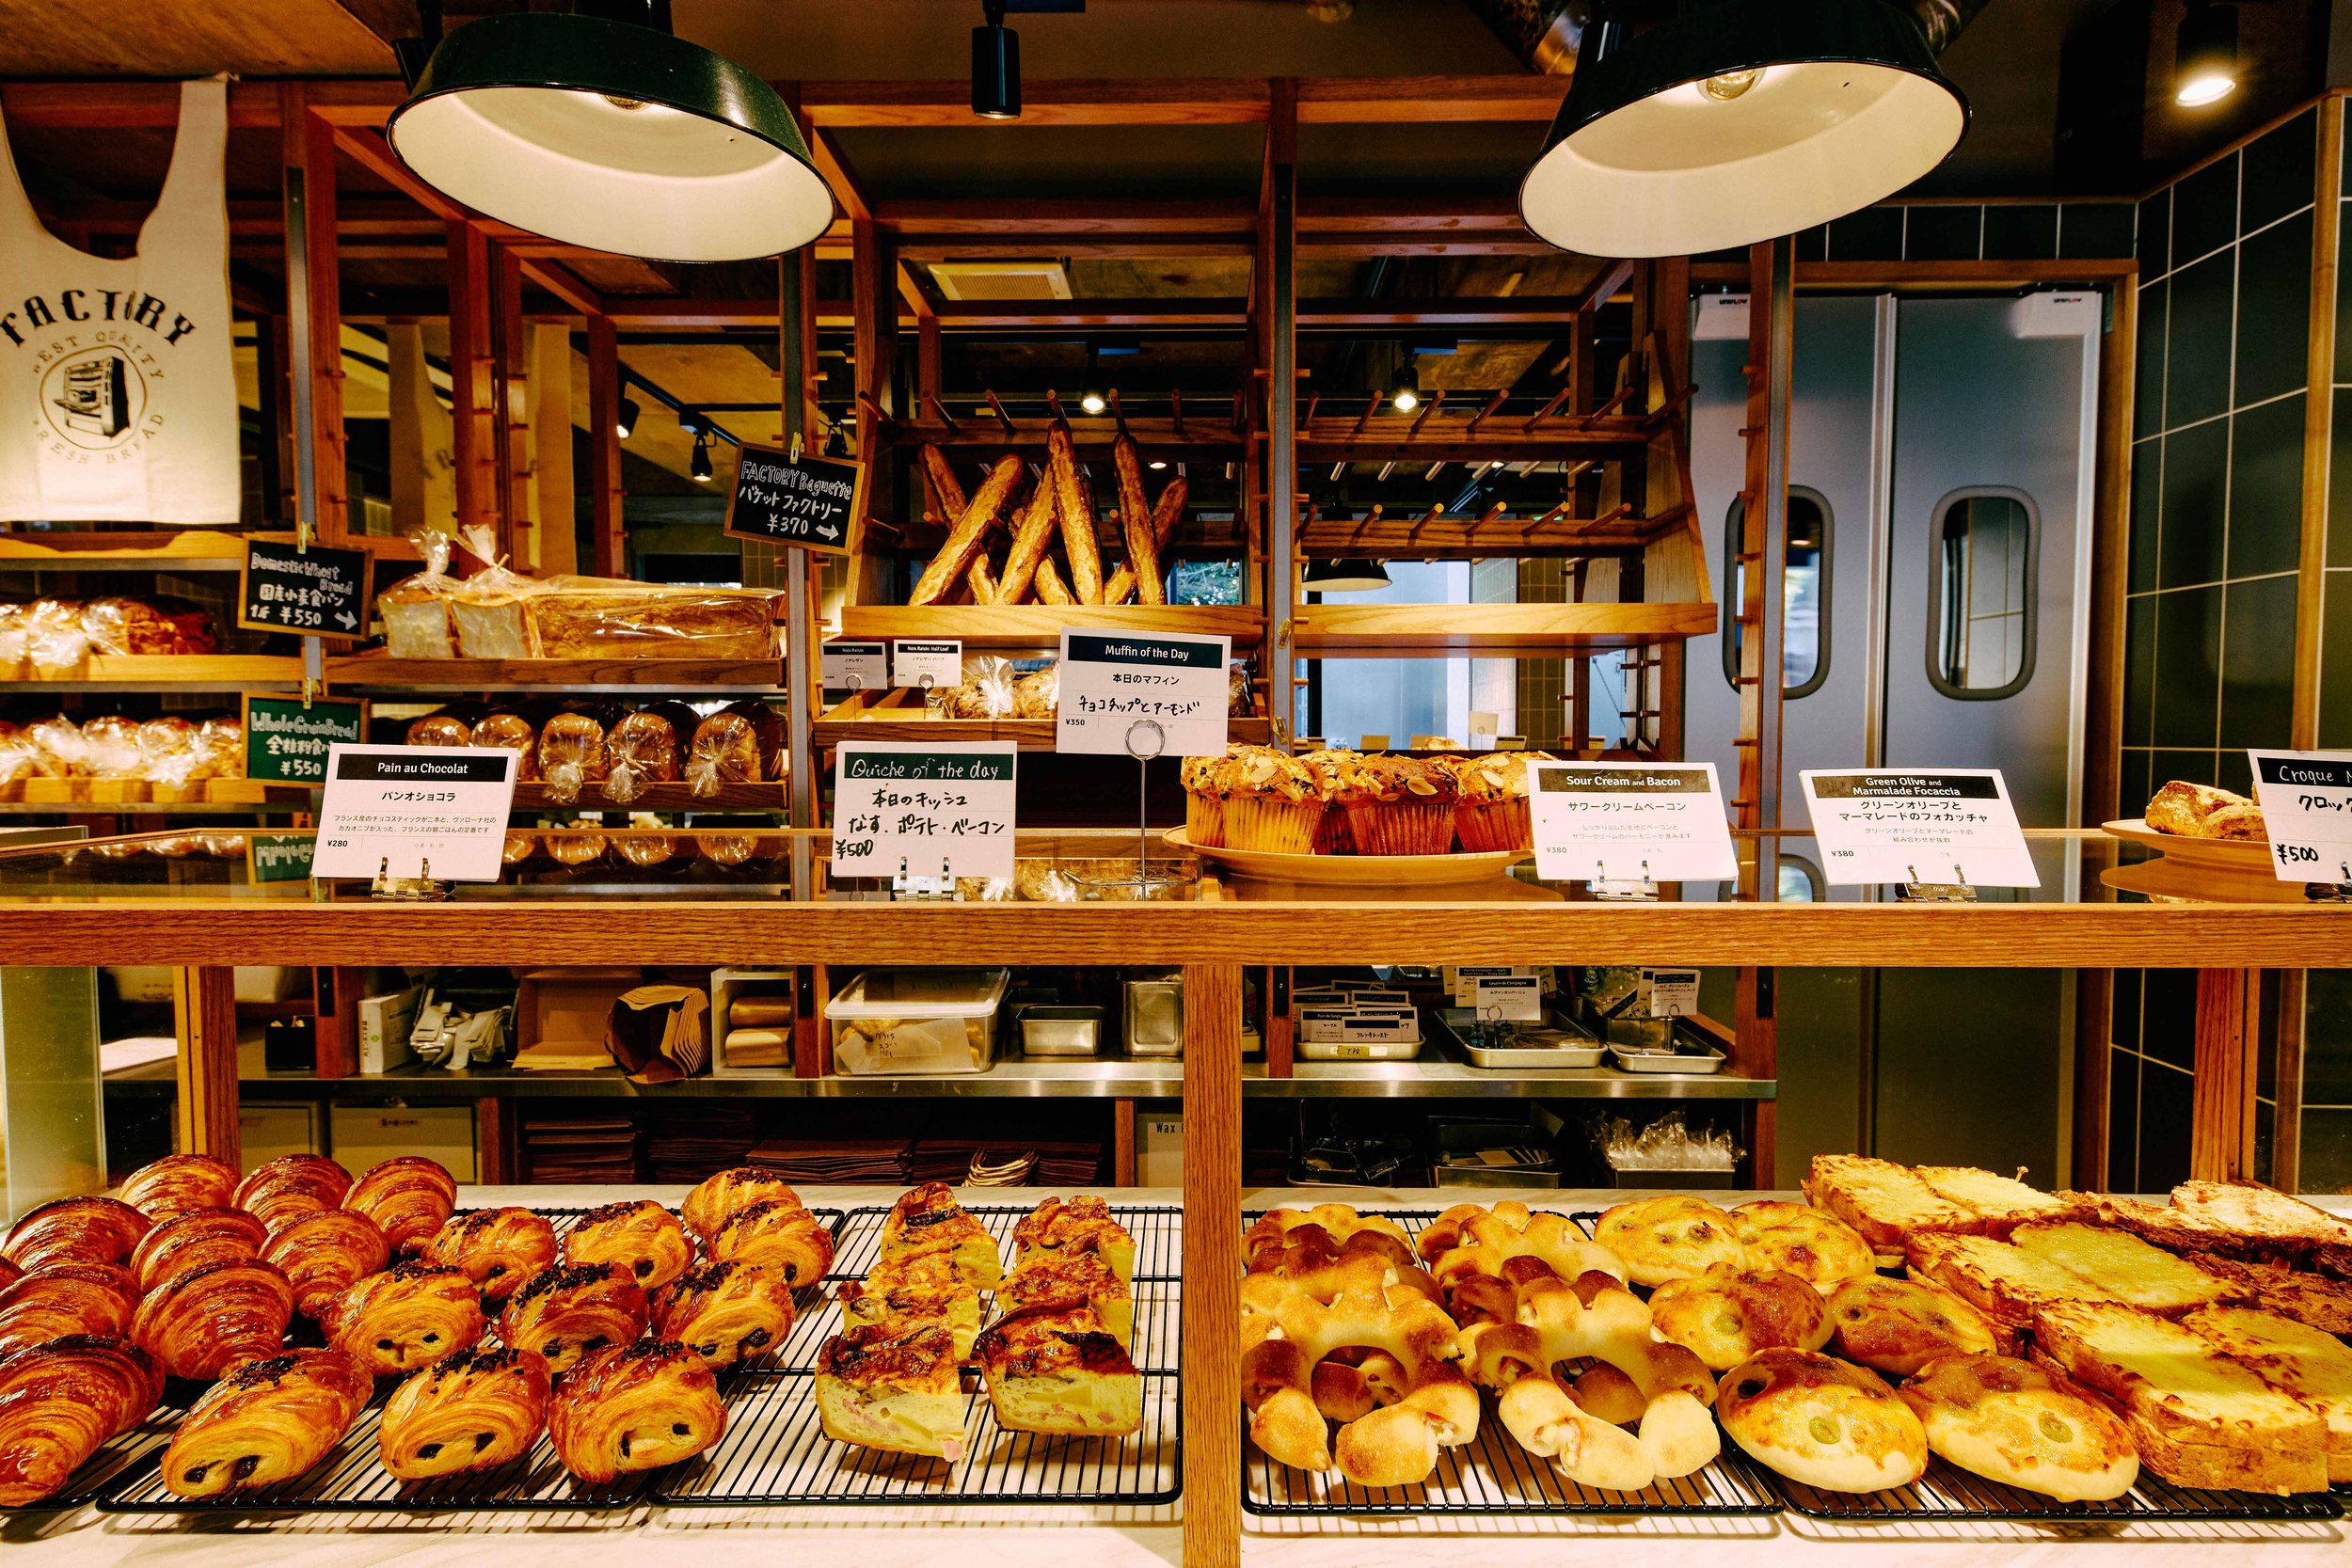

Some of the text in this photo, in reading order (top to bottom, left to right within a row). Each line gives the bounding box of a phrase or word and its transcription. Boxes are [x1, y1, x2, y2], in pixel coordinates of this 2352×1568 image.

[33, 420, 90, 465] RESH
[740, 460, 852, 499] FACTORY Baguette
[767, 514, 808, 534] ¥370
[259, 583, 344, 608] 国産小麦食パン
[279, 606, 322, 626] ¥550
[1104, 644, 1189, 662] Muffin of the Day
[1112, 673, 1180, 686] 本日のマフィン
[1065, 718, 1085, 726] ¥350
[279, 758, 322, 776] ¥550
[377, 762, 469, 774] Pain au Chocolat
[850, 757, 999, 780] Quiche of the day
[1566, 775, 1593, 786] Sour
[1594, 776, 1630, 786] Cream
[1646, 776, 1681, 786] Bacon
[2279, 765, 2334, 784] Croque
[1866, 777, 1898, 786] Green
[1899, 777, 1927, 786] Olive
[381, 790, 456, 802] パンオショコラ
[1852, 786, 1961, 796] Marmalade Focaccia
[871, 788, 968, 810] 本日のキッシュ
[1860, 800, 1962, 810] グリーンオリーブと
[1567, 801, 1687, 812] サワークリームベーコン
[1838, 812, 1988, 823] マーマレードのフォカッチャ
[327, 839, 348, 847] ¥280
[834, 838, 875, 860] ¥500
[1831, 849, 1854, 858] ¥380
[2276, 843, 2319, 865] ¥500
[1156, 1122, 1176, 1133] Wax
